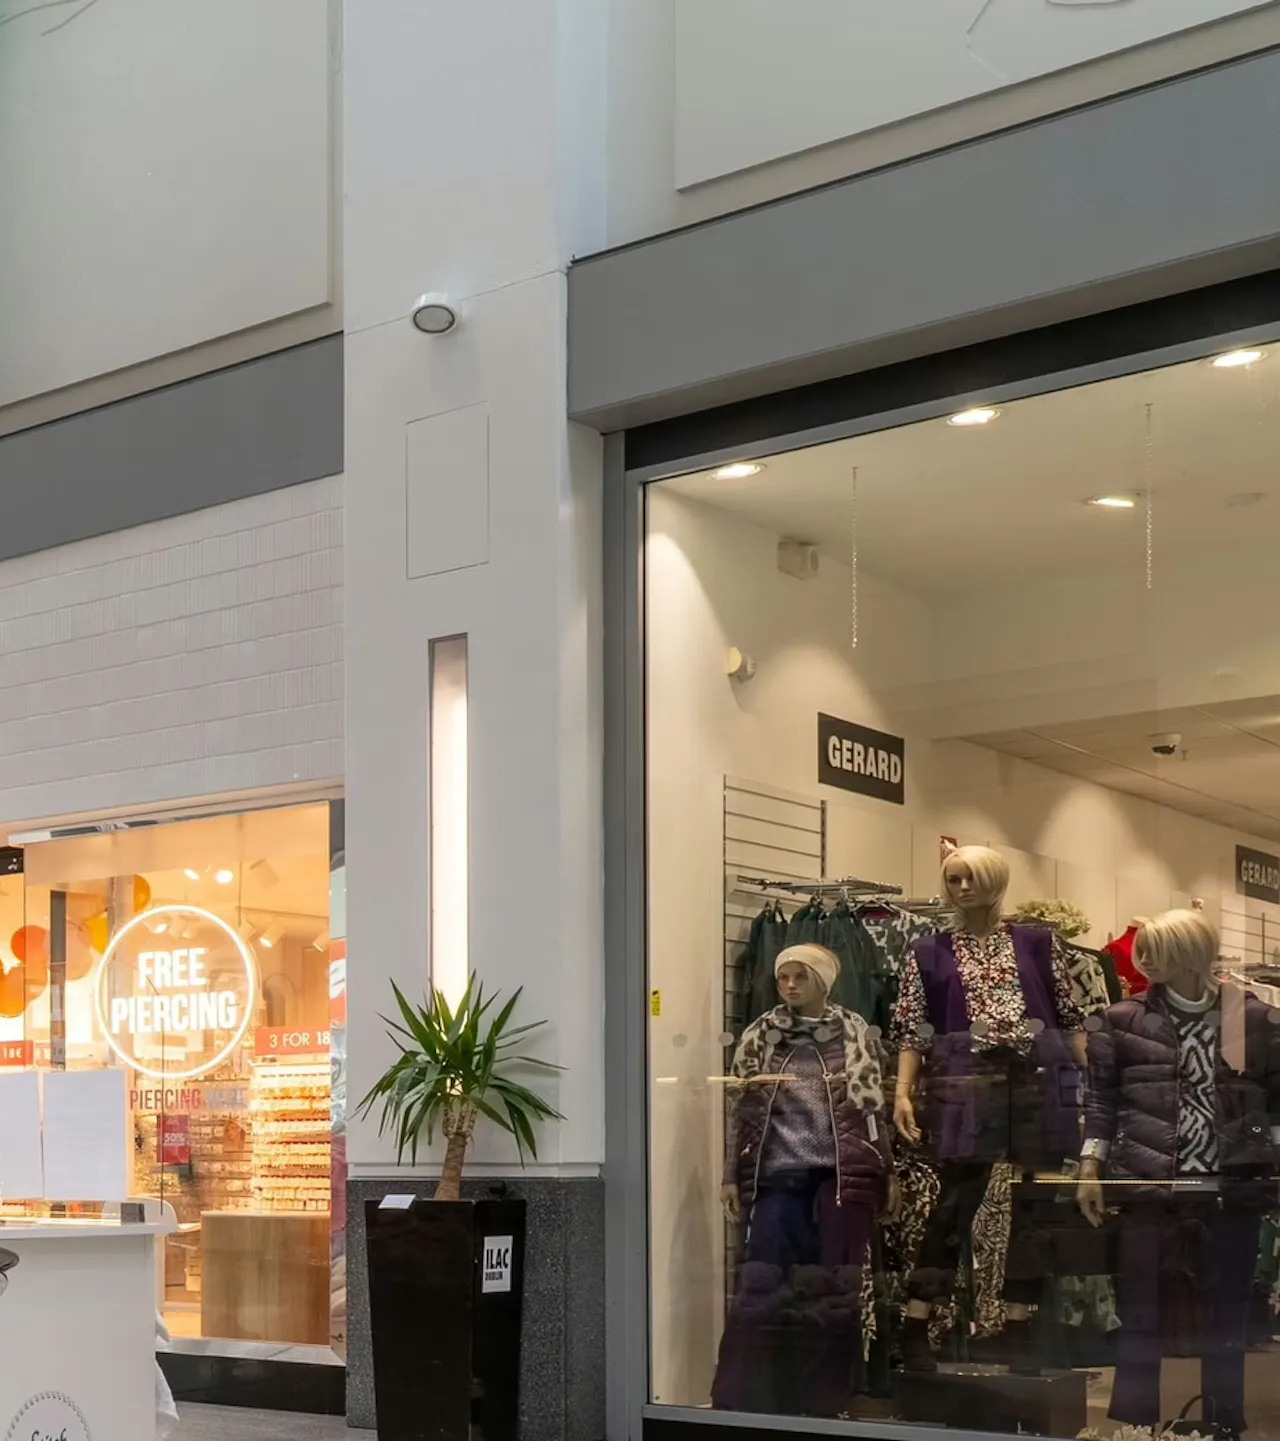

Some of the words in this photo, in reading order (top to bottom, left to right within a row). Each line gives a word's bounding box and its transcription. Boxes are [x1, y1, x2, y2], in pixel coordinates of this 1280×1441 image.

[827, 735, 902, 784] GERARD
[1241, 859, 1280, 890] GERARD
[138, 947, 208, 989] FREE
[110, 991, 237, 1035] PIERCING
[3, 1047, 23, 1060] 18€
[269, 1034, 278, 1049] 3
[282, 1032, 310, 1047] FOR
[129, 1088, 202, 1110] PIERCING
[486, 1248, 510, 1270] ILAC
